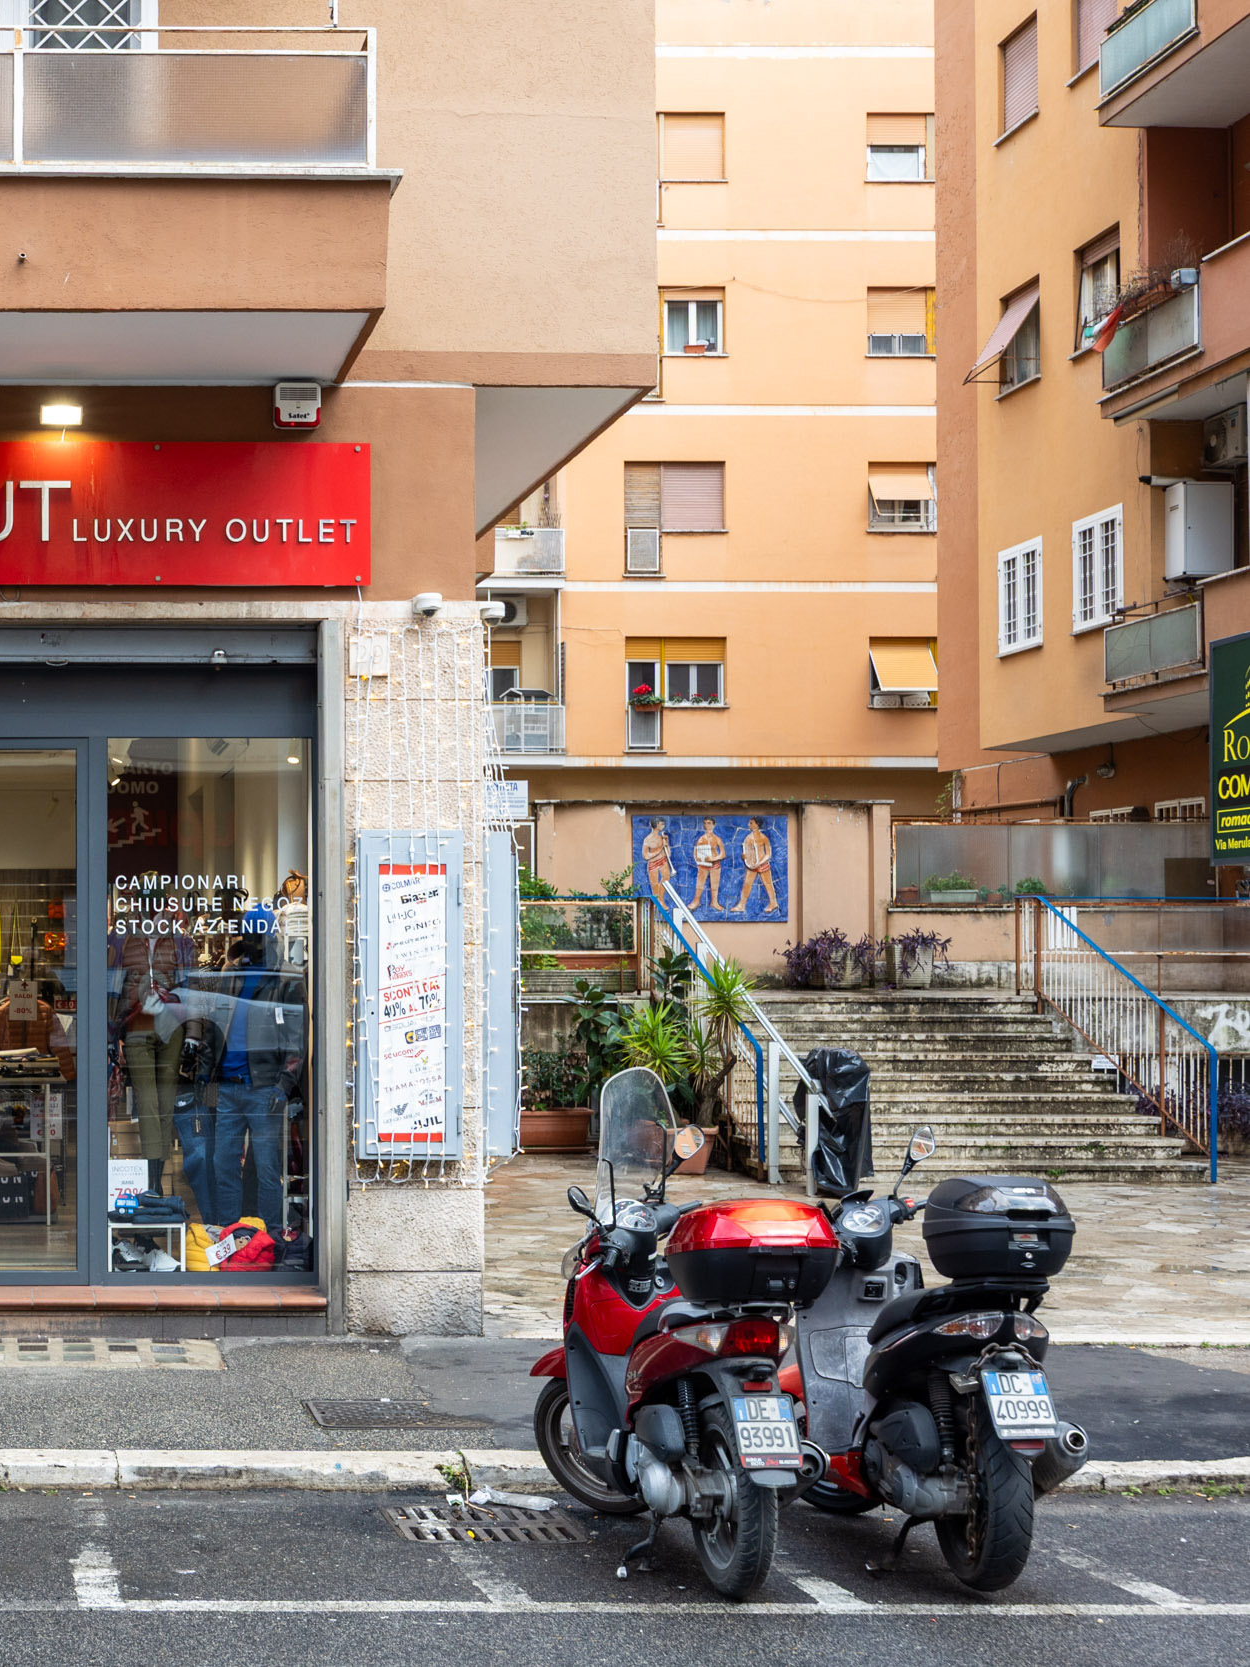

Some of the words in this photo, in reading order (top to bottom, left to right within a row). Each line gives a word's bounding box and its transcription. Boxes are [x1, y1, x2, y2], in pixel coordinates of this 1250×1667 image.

[73, 518, 208, 542] LUXURY
[225, 518, 358, 543] OUTLET
[1215, 838, 1226, 850] Via
[115, 875, 246, 890] CAMPIONARI
[115, 897, 222, 912] CHIUSURE
[115, 920, 184, 934] STOCK
[998, 1374, 1022, 1393] DC
[746, 1398, 770, 1420] DE
[996, 1400, 1051, 1420] 40999
[740, 1426, 794, 1448] 93991
